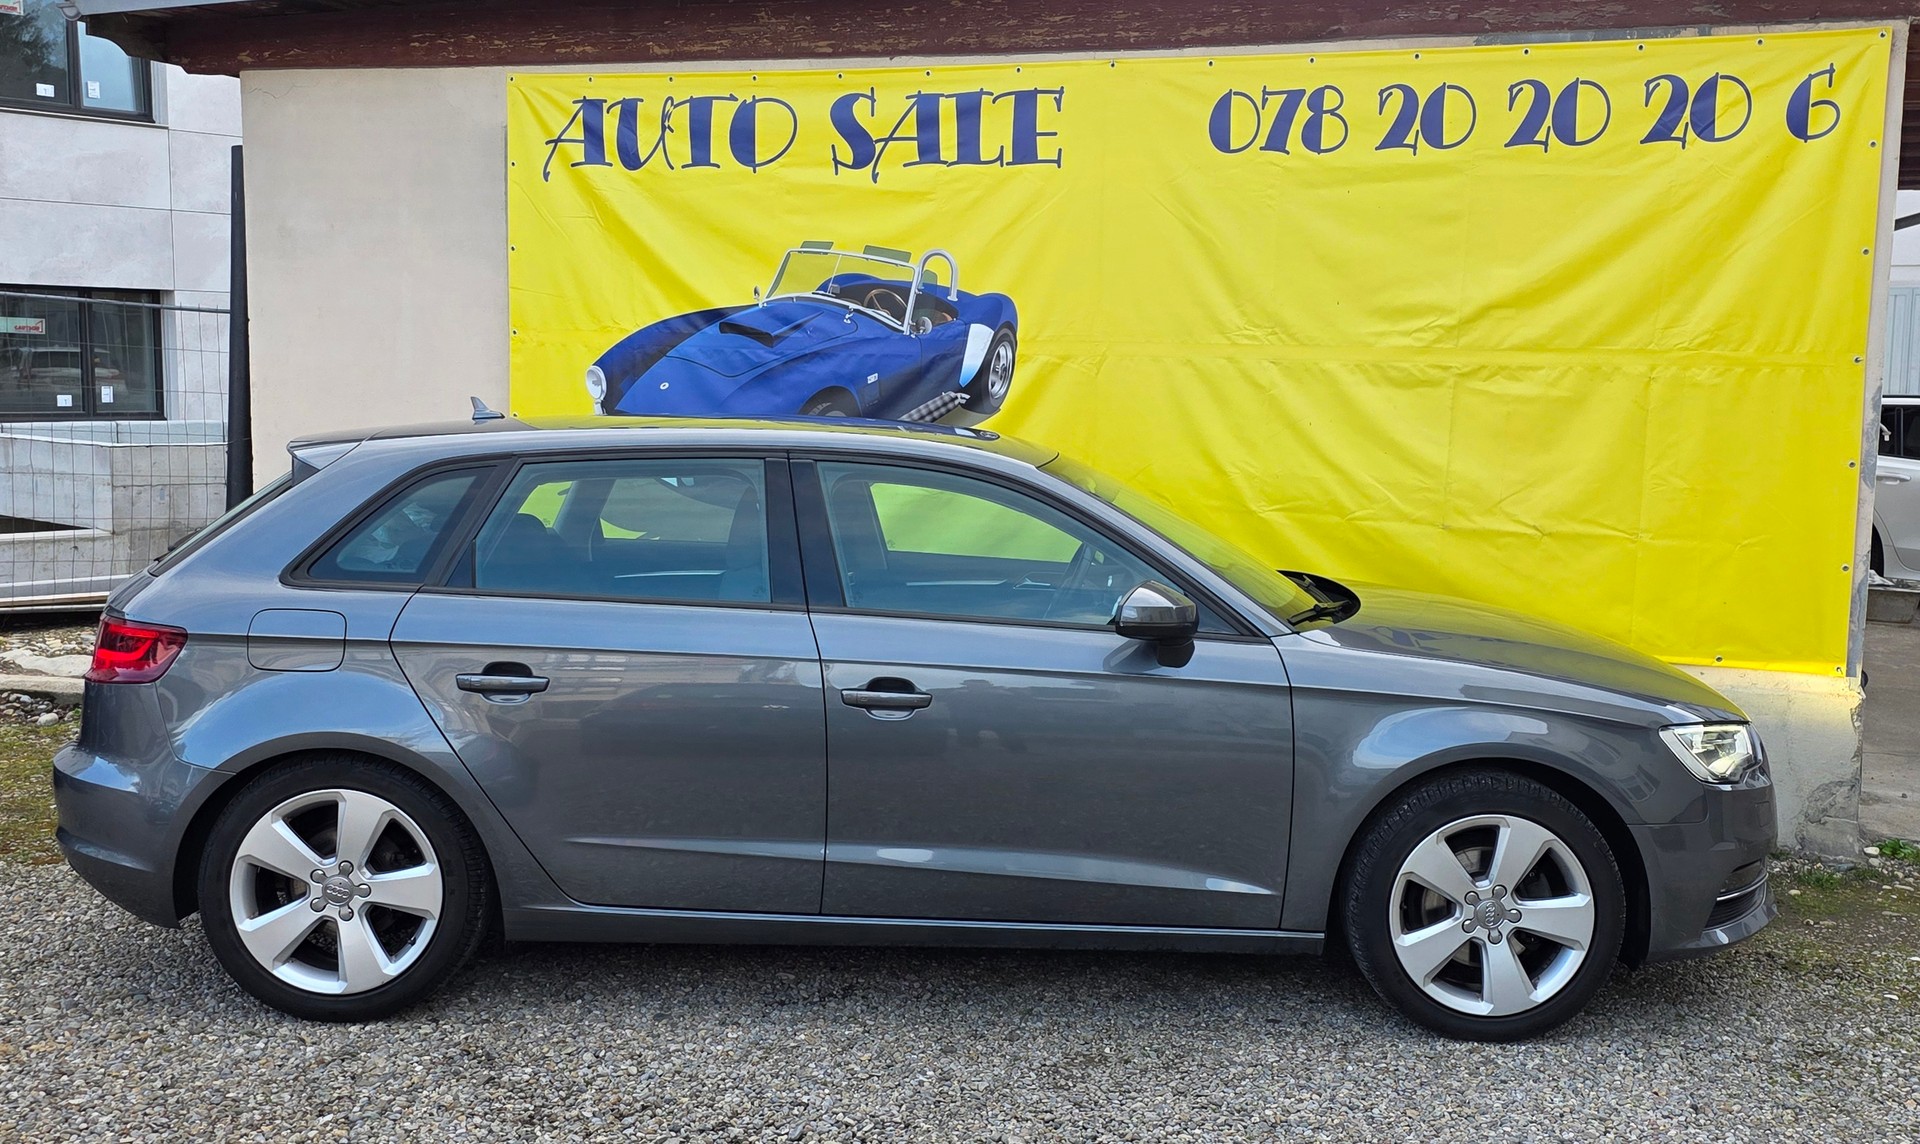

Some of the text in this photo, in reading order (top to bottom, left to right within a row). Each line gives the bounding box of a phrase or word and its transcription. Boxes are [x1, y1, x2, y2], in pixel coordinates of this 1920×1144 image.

[543, 86, 1065, 184] AUTO SALE
[1208, 62, 1842, 156] 078 20 20 20 6
